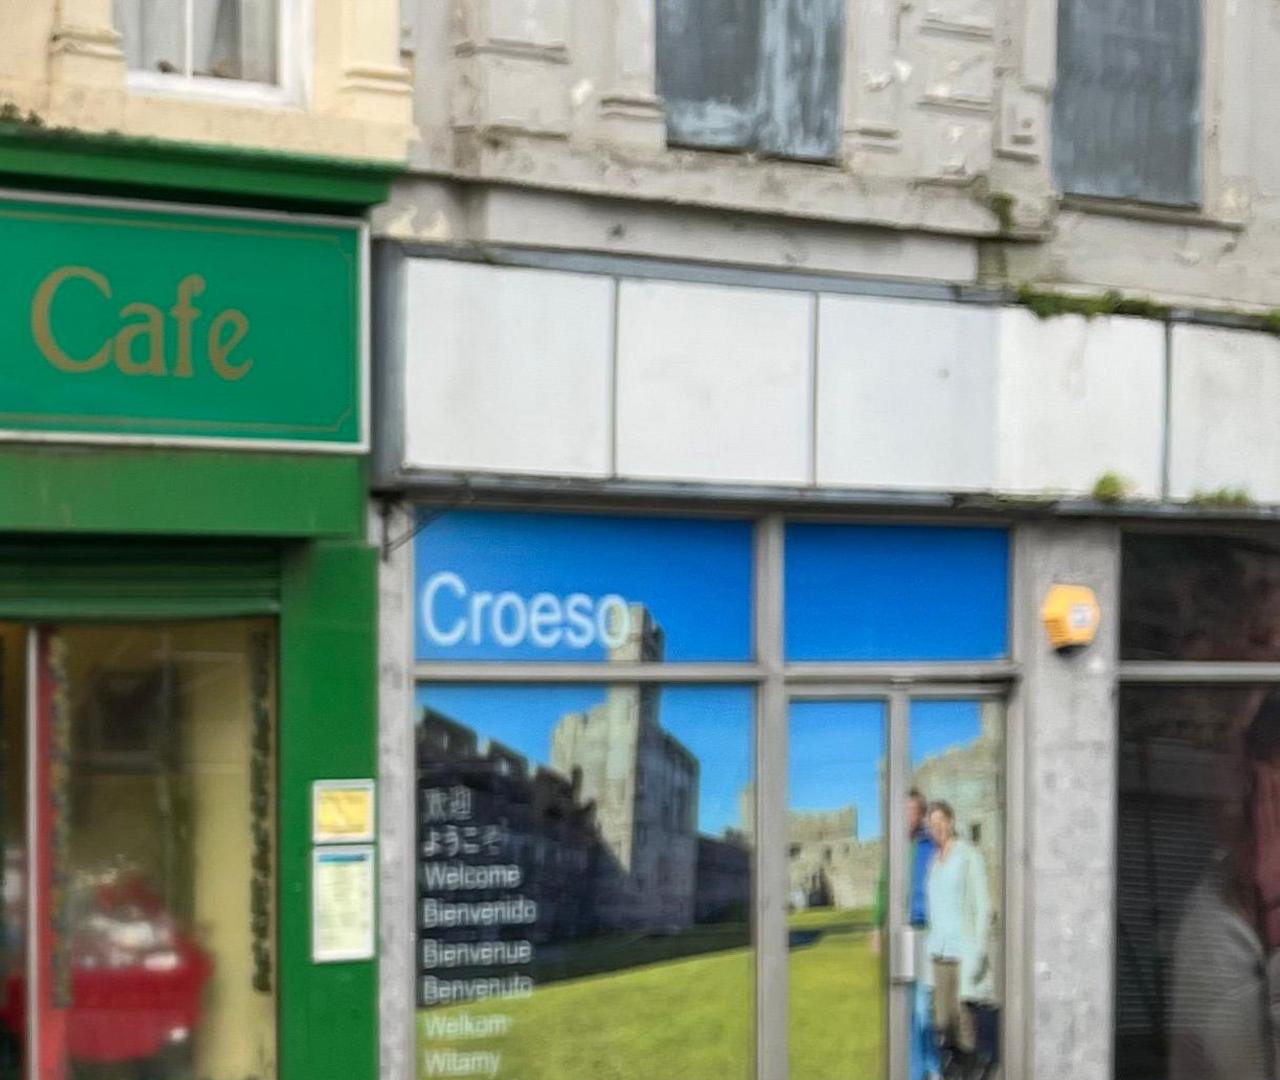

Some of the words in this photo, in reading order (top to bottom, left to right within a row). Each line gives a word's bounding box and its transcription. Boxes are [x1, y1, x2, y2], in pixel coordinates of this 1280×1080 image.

[31, 265, 253, 380] Cafe
[422, 571, 630, 648] Croeso
[425, 864, 521, 890] Welcome
[424, 897, 536, 928] Bienvenido
[424, 939, 531, 969] Bienvenue
[424, 974, 533, 1005] Benvenuto
